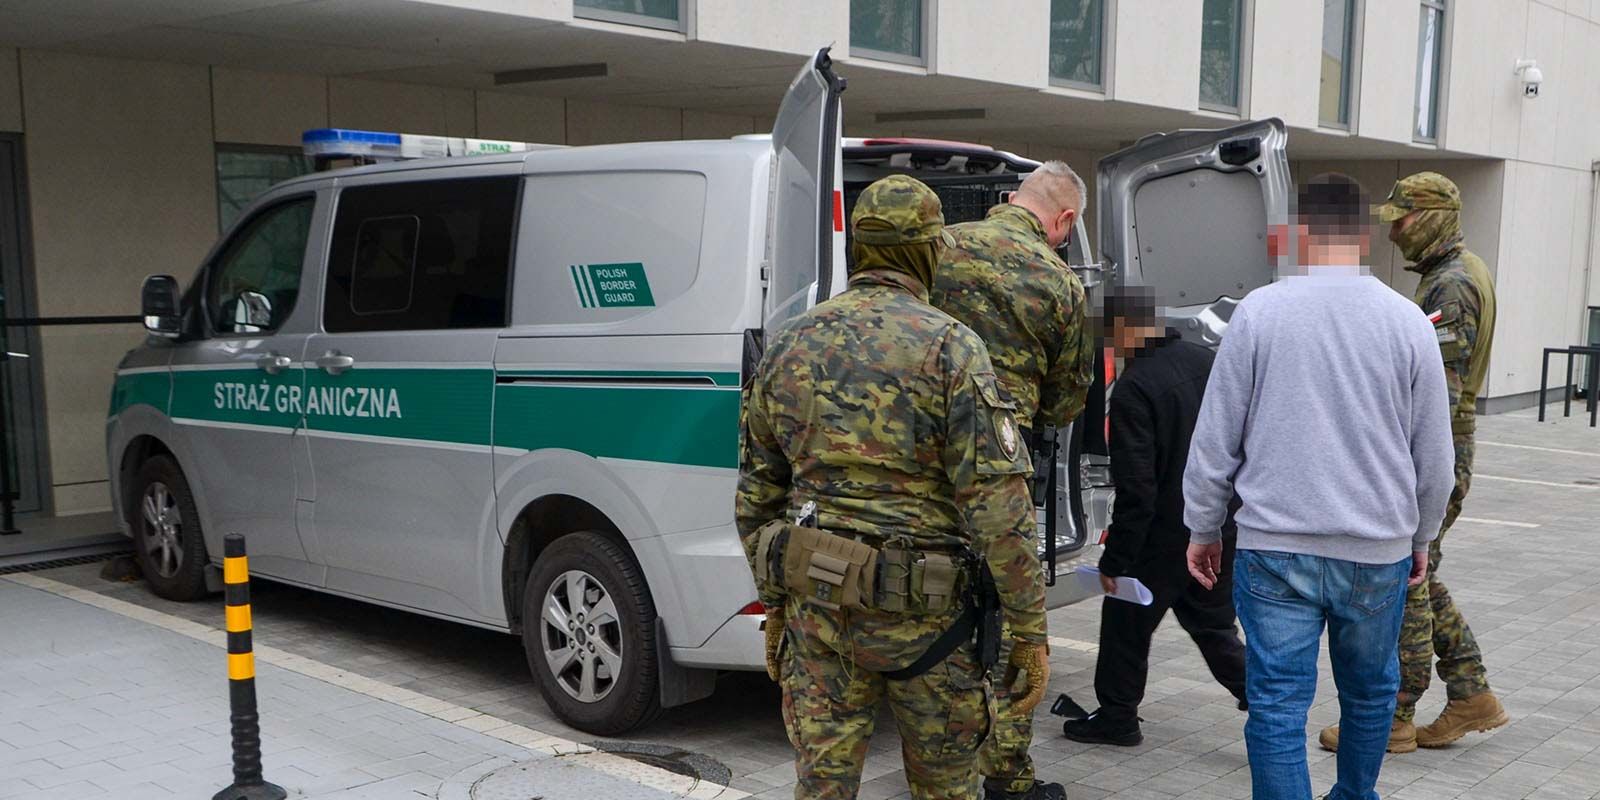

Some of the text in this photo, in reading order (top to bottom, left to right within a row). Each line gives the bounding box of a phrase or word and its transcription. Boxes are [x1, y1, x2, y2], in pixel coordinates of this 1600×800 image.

[595, 268, 628, 279] POLISH
[600, 280, 637, 291] BORDER
[604, 292, 635, 303] GUARD
[213, 379, 402, 418] STRAŻ GRANICZNA
